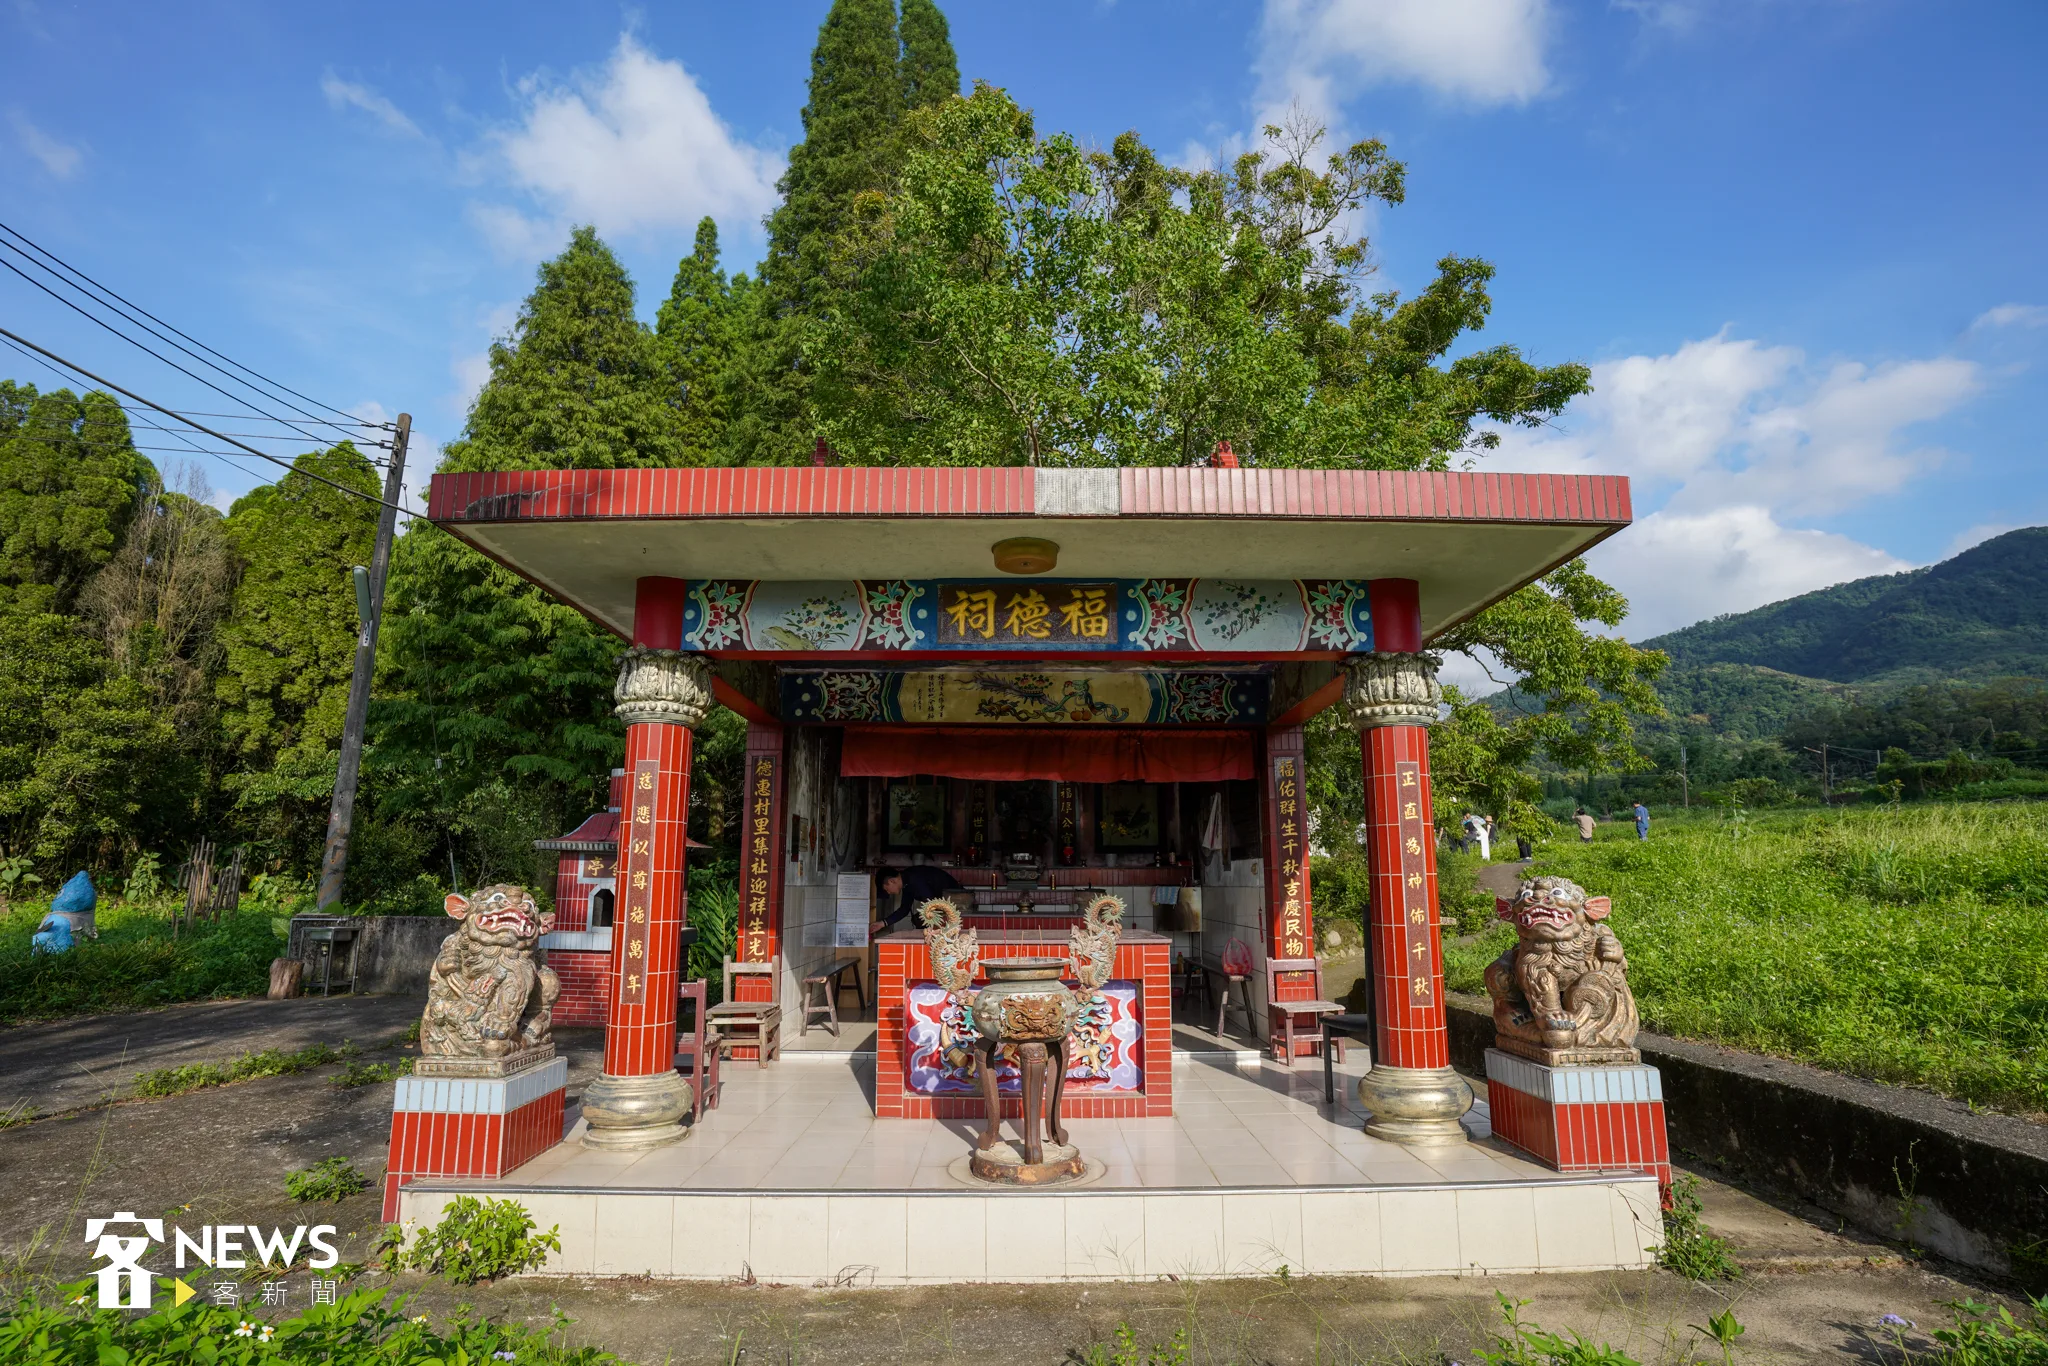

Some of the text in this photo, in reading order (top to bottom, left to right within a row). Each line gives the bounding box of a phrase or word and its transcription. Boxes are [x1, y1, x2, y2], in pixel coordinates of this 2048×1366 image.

[946, 588, 1109, 638] 福德祠
[626, 771, 653, 996] 慈悲以尊施萬年
